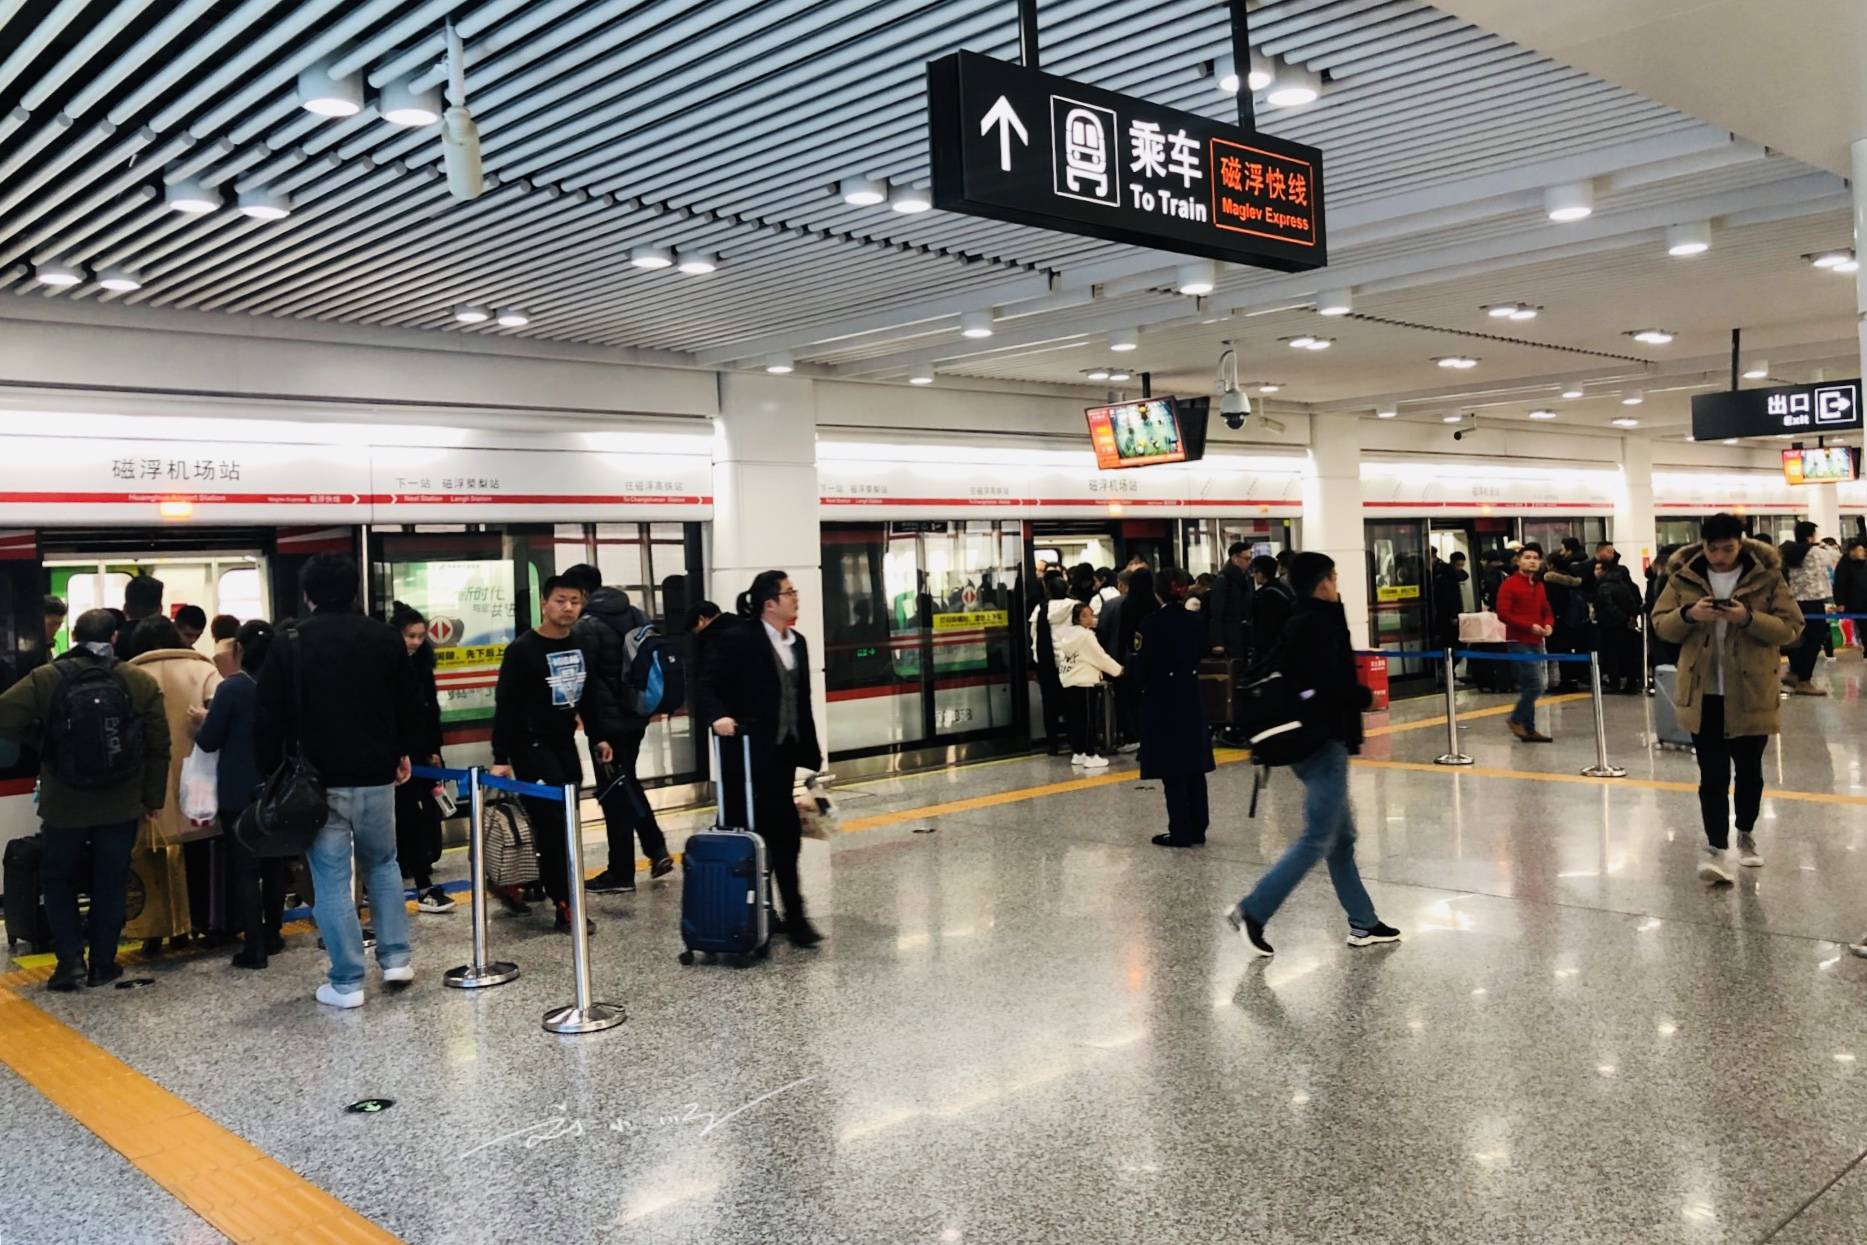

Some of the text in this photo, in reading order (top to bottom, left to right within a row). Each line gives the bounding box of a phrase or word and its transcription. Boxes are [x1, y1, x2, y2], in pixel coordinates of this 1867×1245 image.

[1129, 120, 1203, 189] 乘车
[1220, 156, 1307, 206] 磁浮快线
[1129, 183, 1208, 223] To Train
[1221, 197, 1310, 231] Maglev Express
[1768, 393, 1810, 415] 出口
[1783, 414, 1810, 427] Exit
[112, 459, 241, 482] 磁浮机场站
